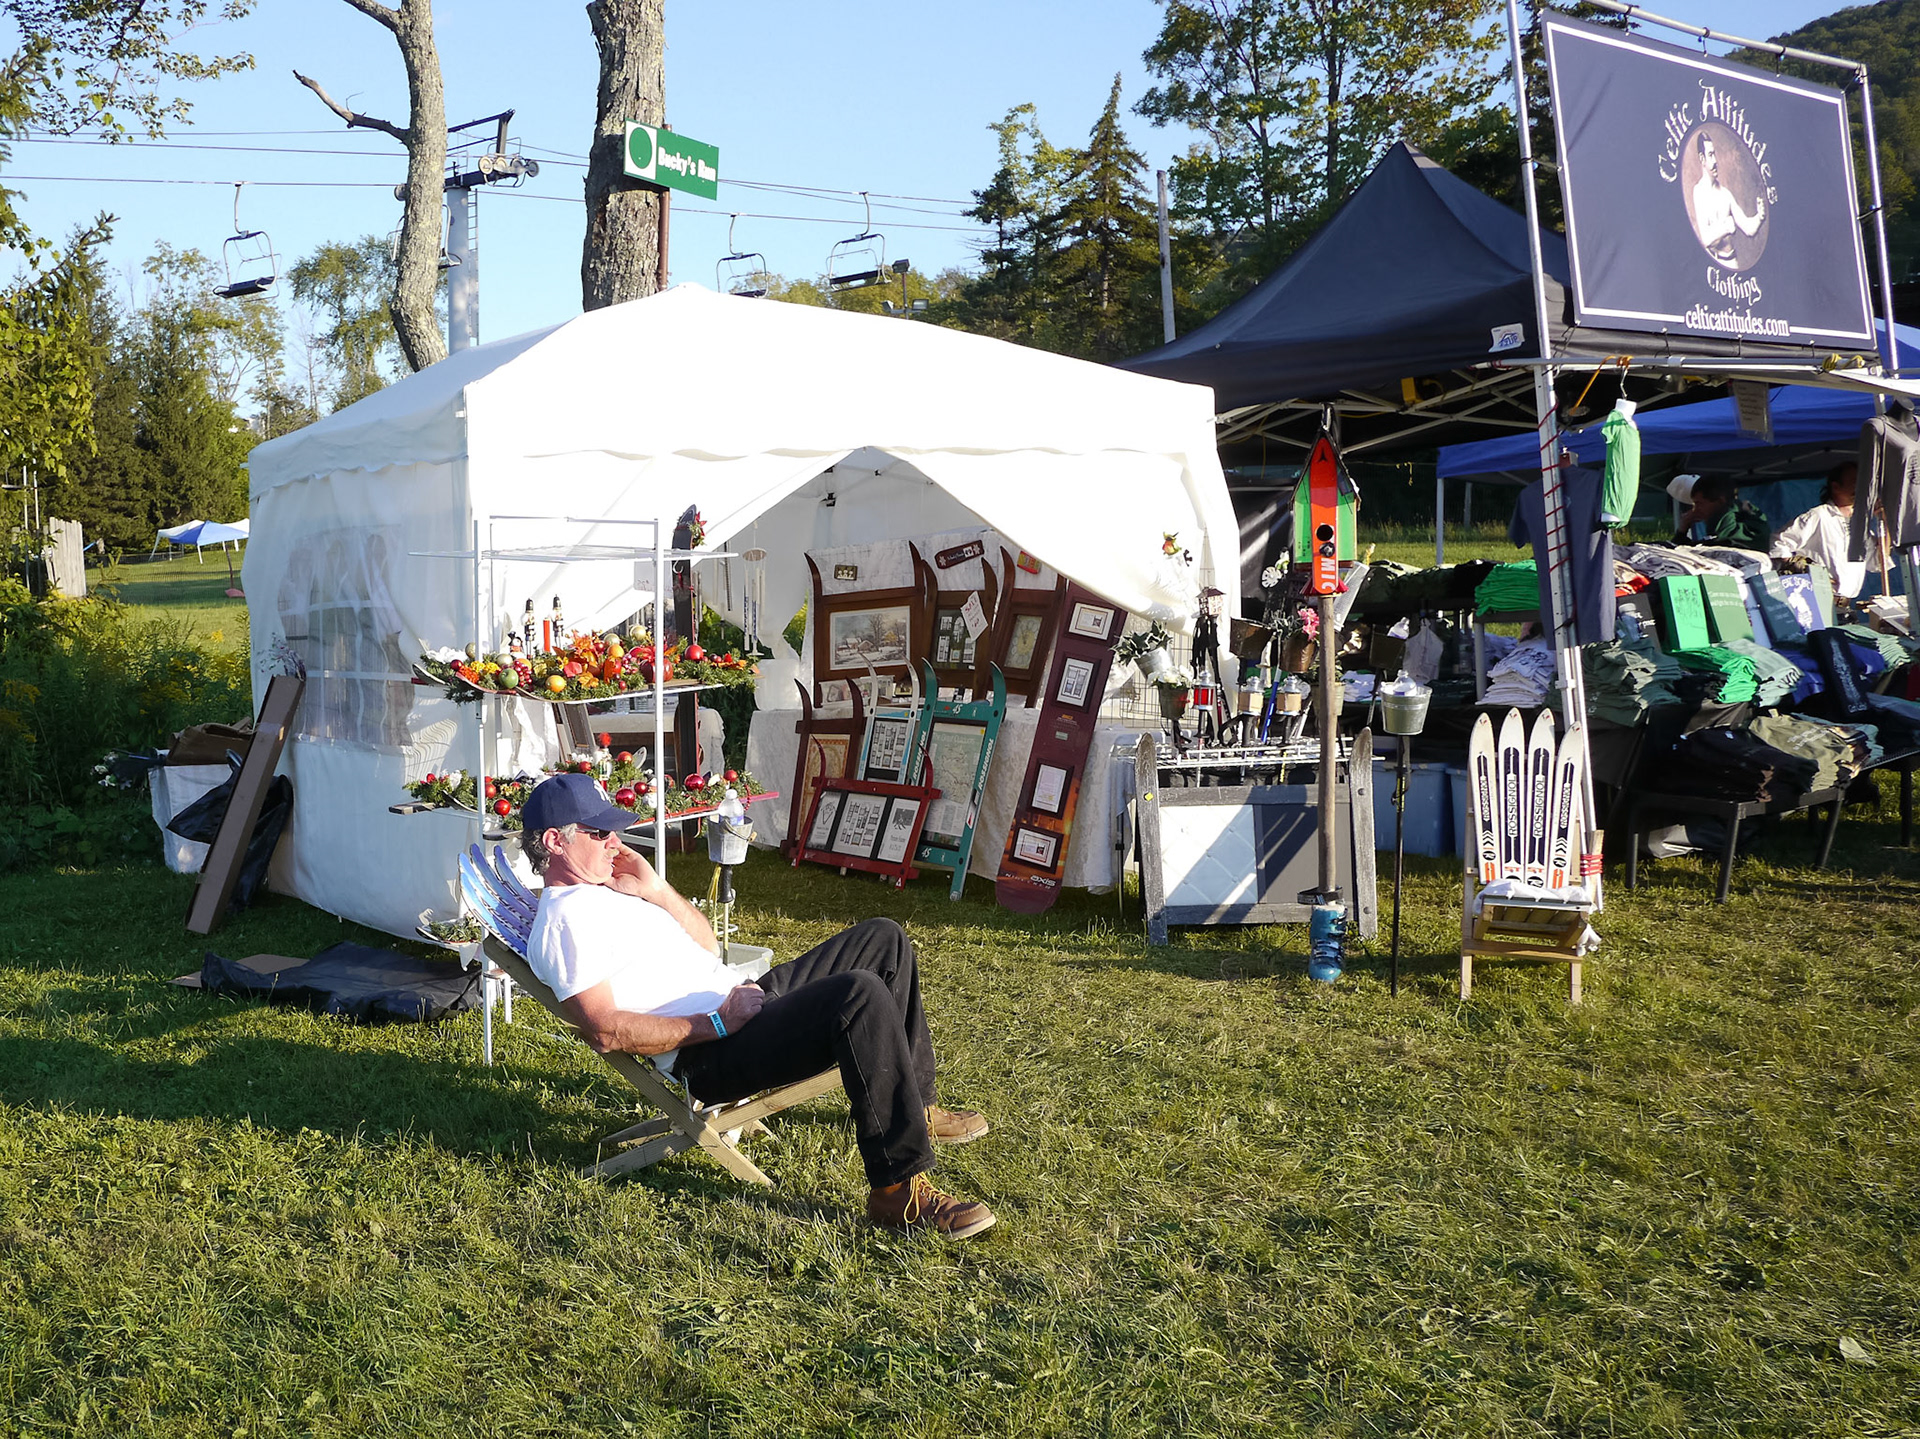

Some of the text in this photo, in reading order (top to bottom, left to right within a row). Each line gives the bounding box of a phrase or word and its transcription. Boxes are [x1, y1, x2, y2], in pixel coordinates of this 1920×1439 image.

[1658, 78, 1778, 205] Celtic Attitudes
[1706, 266, 1762, 306] Clothing
[1685, 303, 1790, 336] celticattitudes.com
[978, 738, 994, 790] ROSSIGNOL
[1508, 778, 1518, 837] ROSSIGNOL
[1534, 779, 1545, 837] ROSSIGNOL
